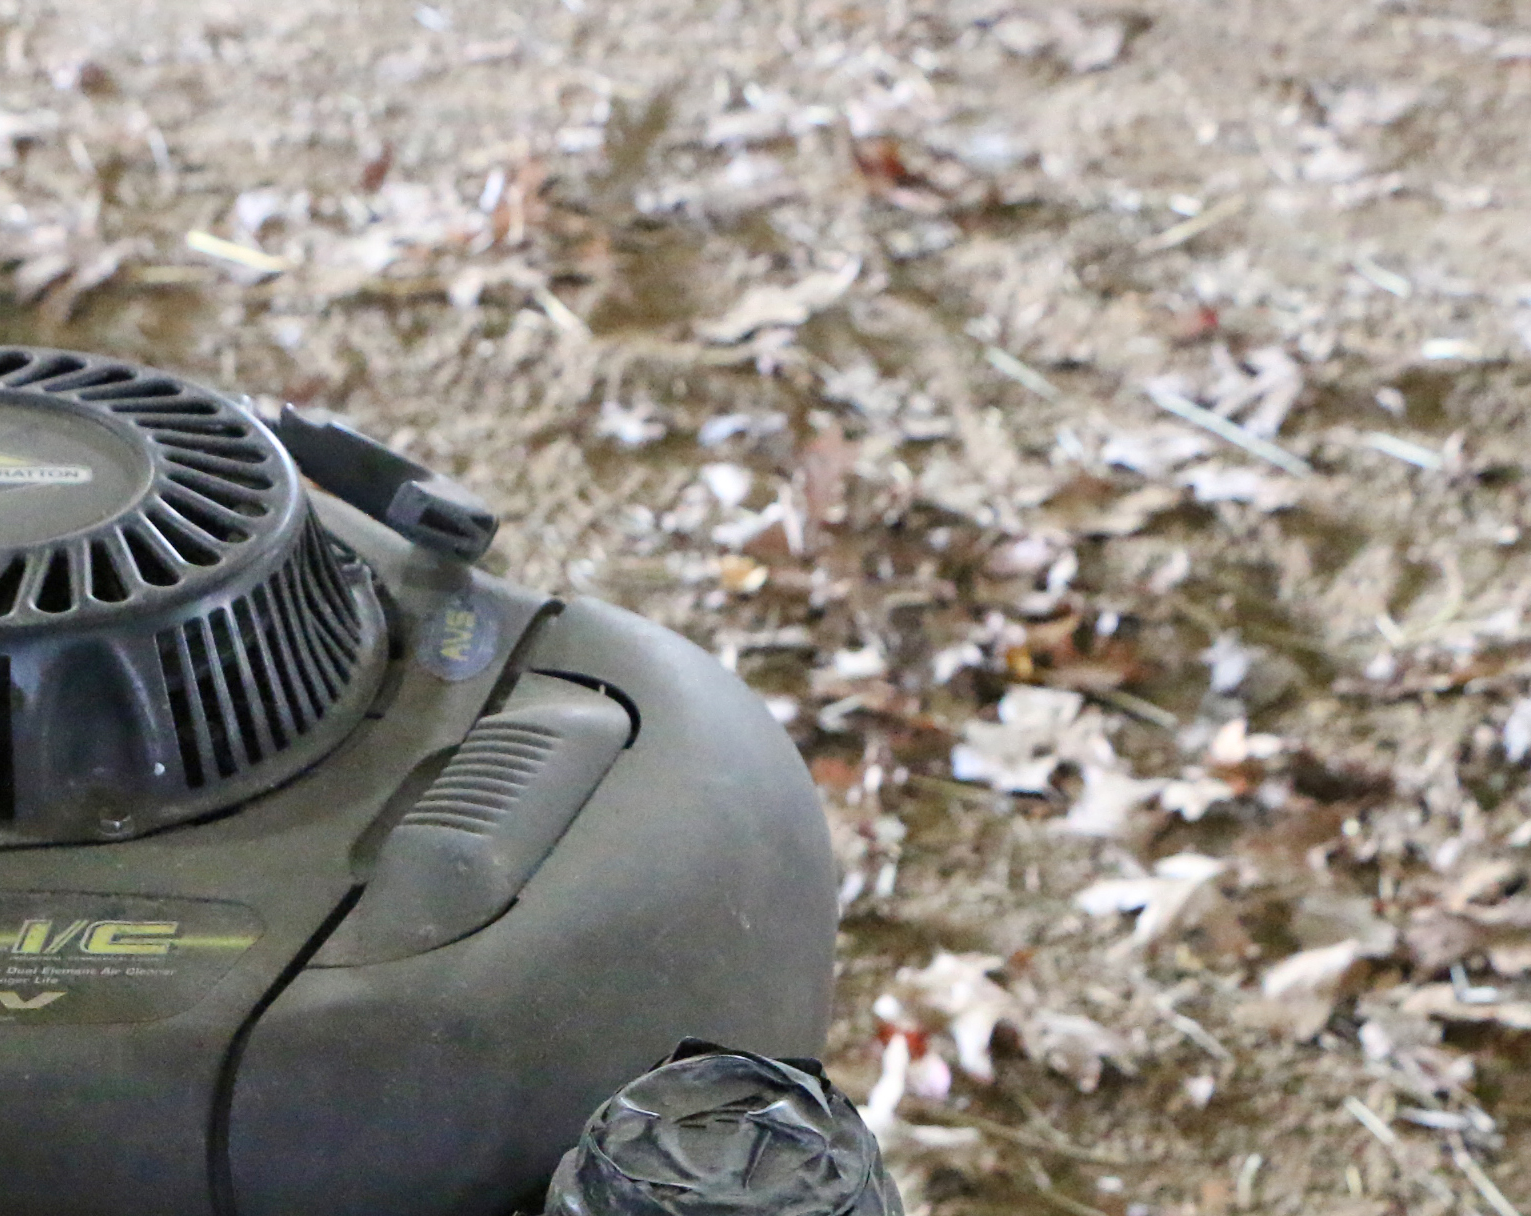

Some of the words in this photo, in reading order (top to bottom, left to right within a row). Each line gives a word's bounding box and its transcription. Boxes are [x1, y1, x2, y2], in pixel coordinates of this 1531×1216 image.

[7, 967, 38, 975] Dual
[41, 966, 97, 975] Element
[100, 967, 121, 976] Air
[34, 976, 60, 984] Life
